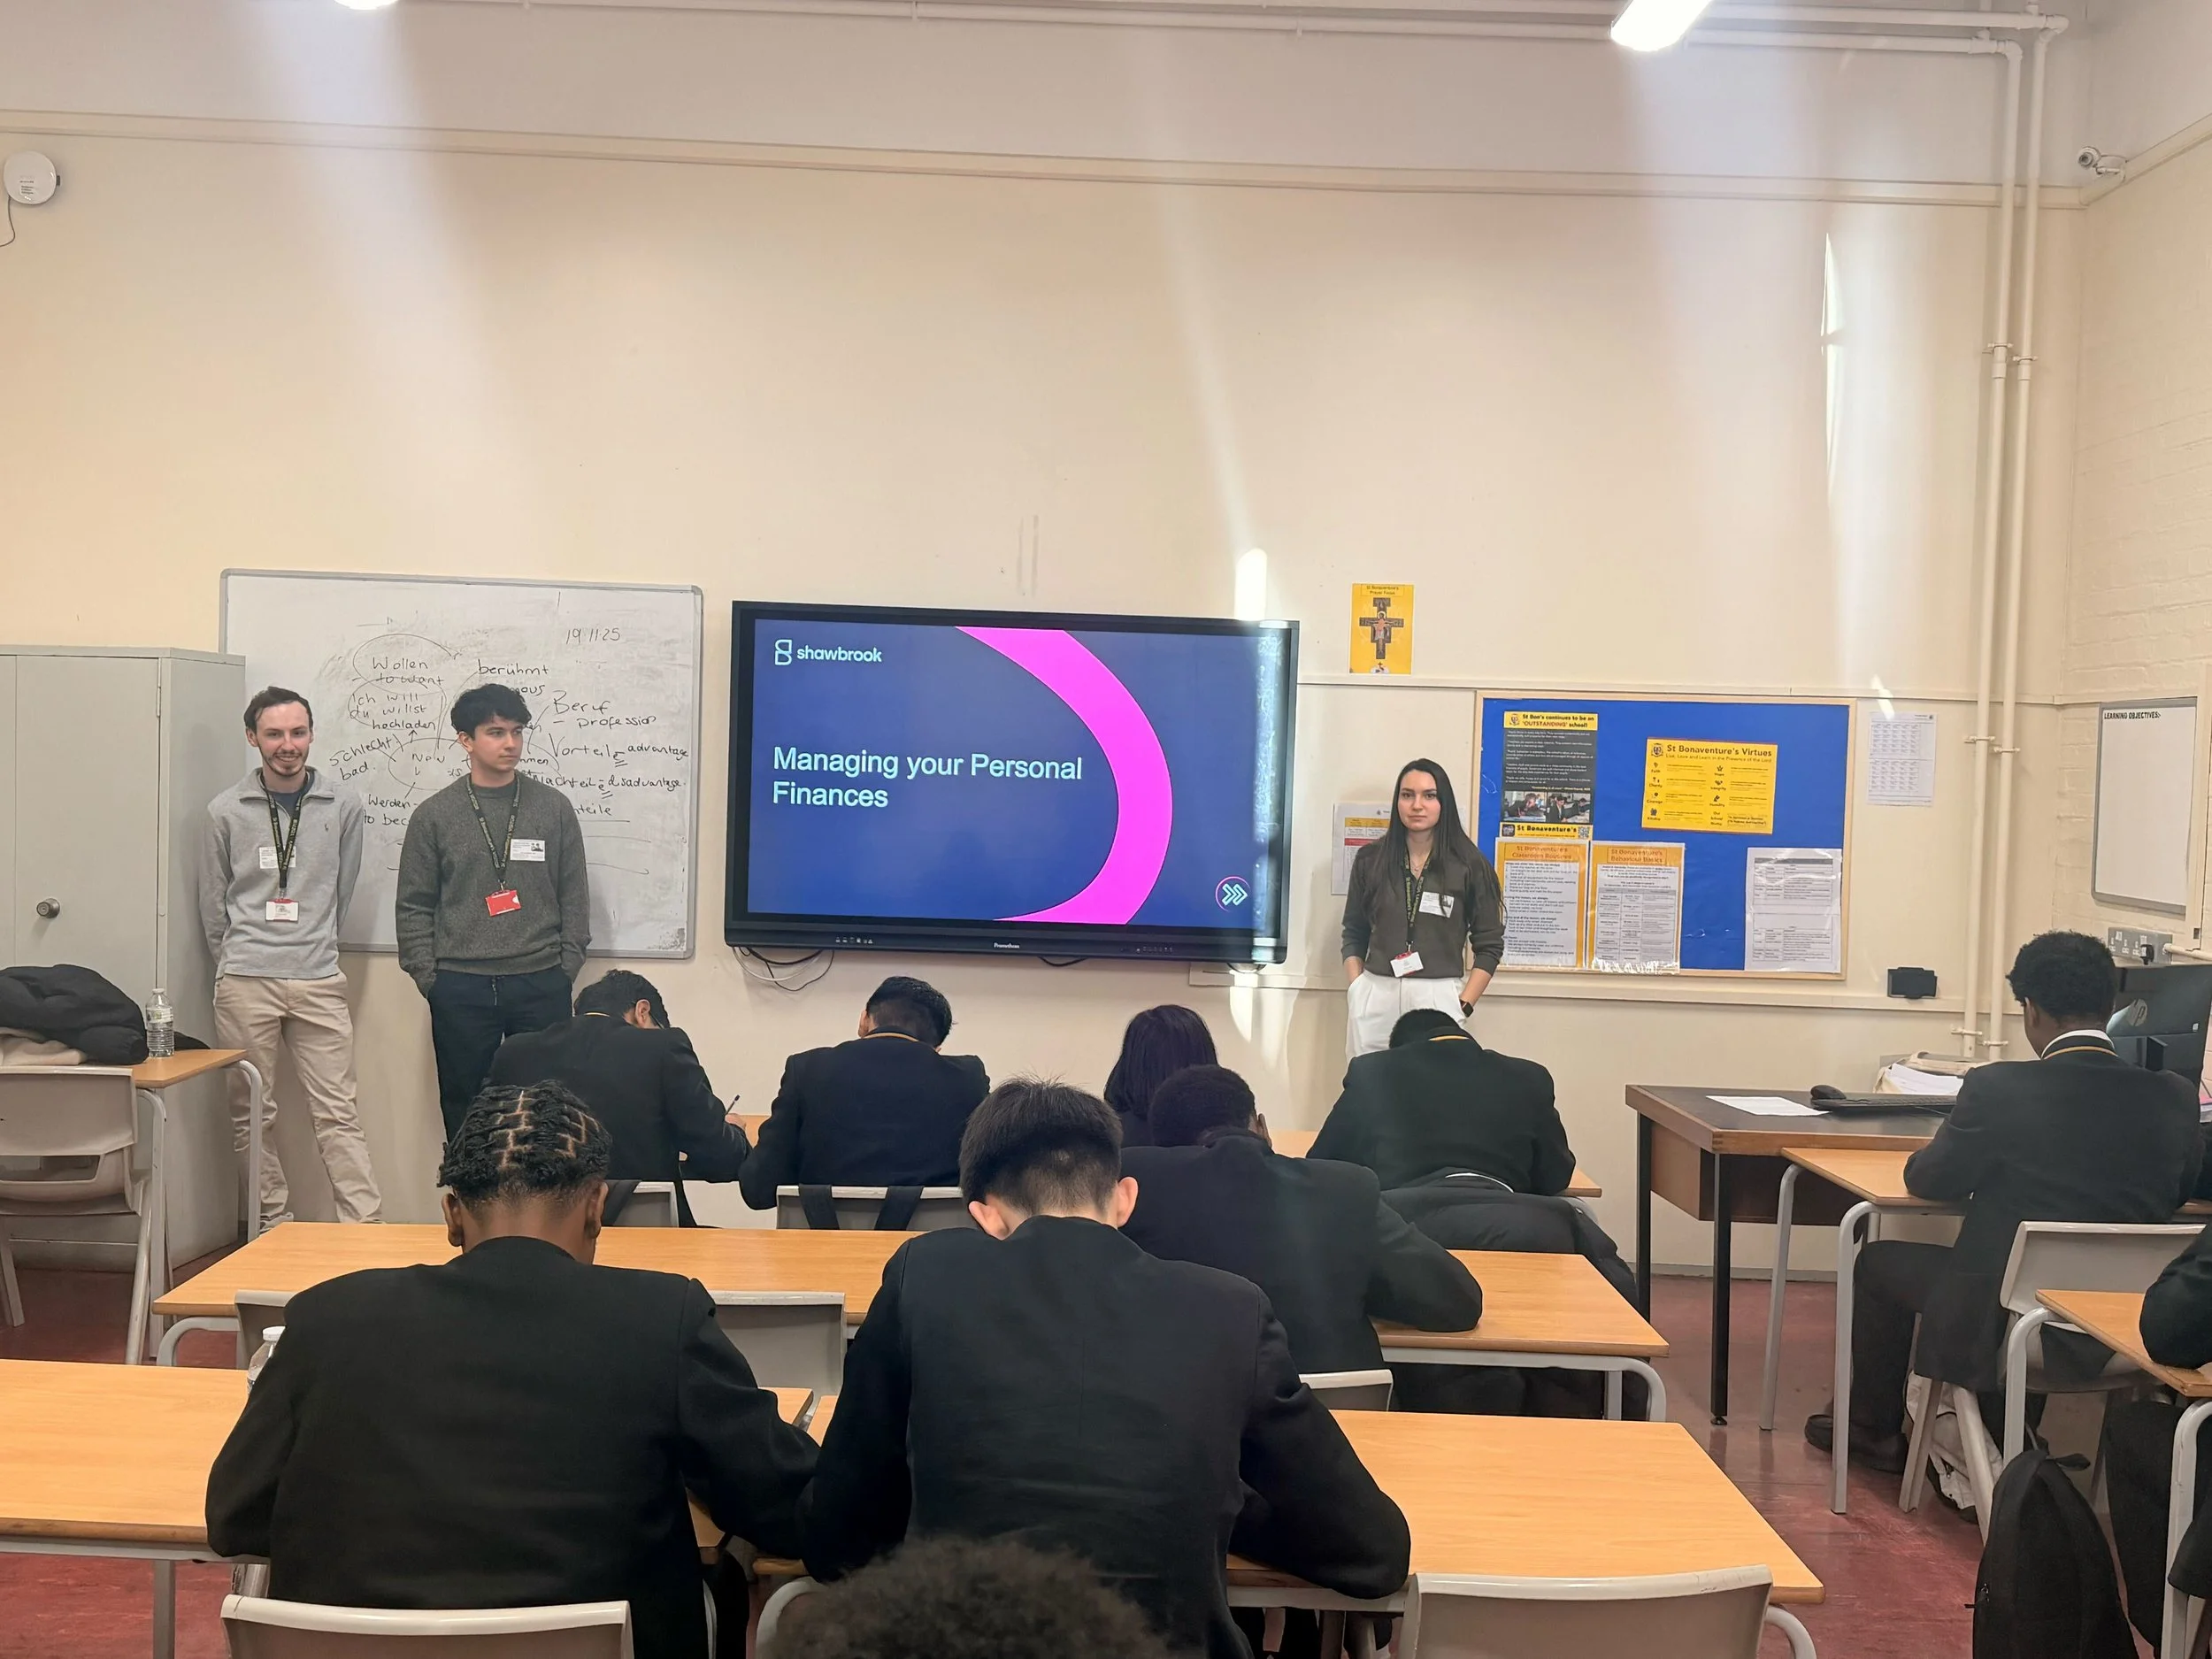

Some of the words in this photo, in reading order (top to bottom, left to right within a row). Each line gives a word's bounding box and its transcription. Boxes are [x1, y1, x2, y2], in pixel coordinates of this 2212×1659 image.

[796, 646, 882, 663] shawbrook
[373, 657, 428, 670] Wollen
[478, 658, 549, 675] berühmt
[401, 676, 444, 687] want
[552, 690, 611, 714] Beruf
[372, 719, 436, 732] hochladen
[577, 715, 657, 729] profession
[627, 743, 689, 761] advantage
[1679, 745, 1740, 755] Bonaventure's
[1741, 748, 1771, 757] Virtues
[364, 810, 375, 825] to
